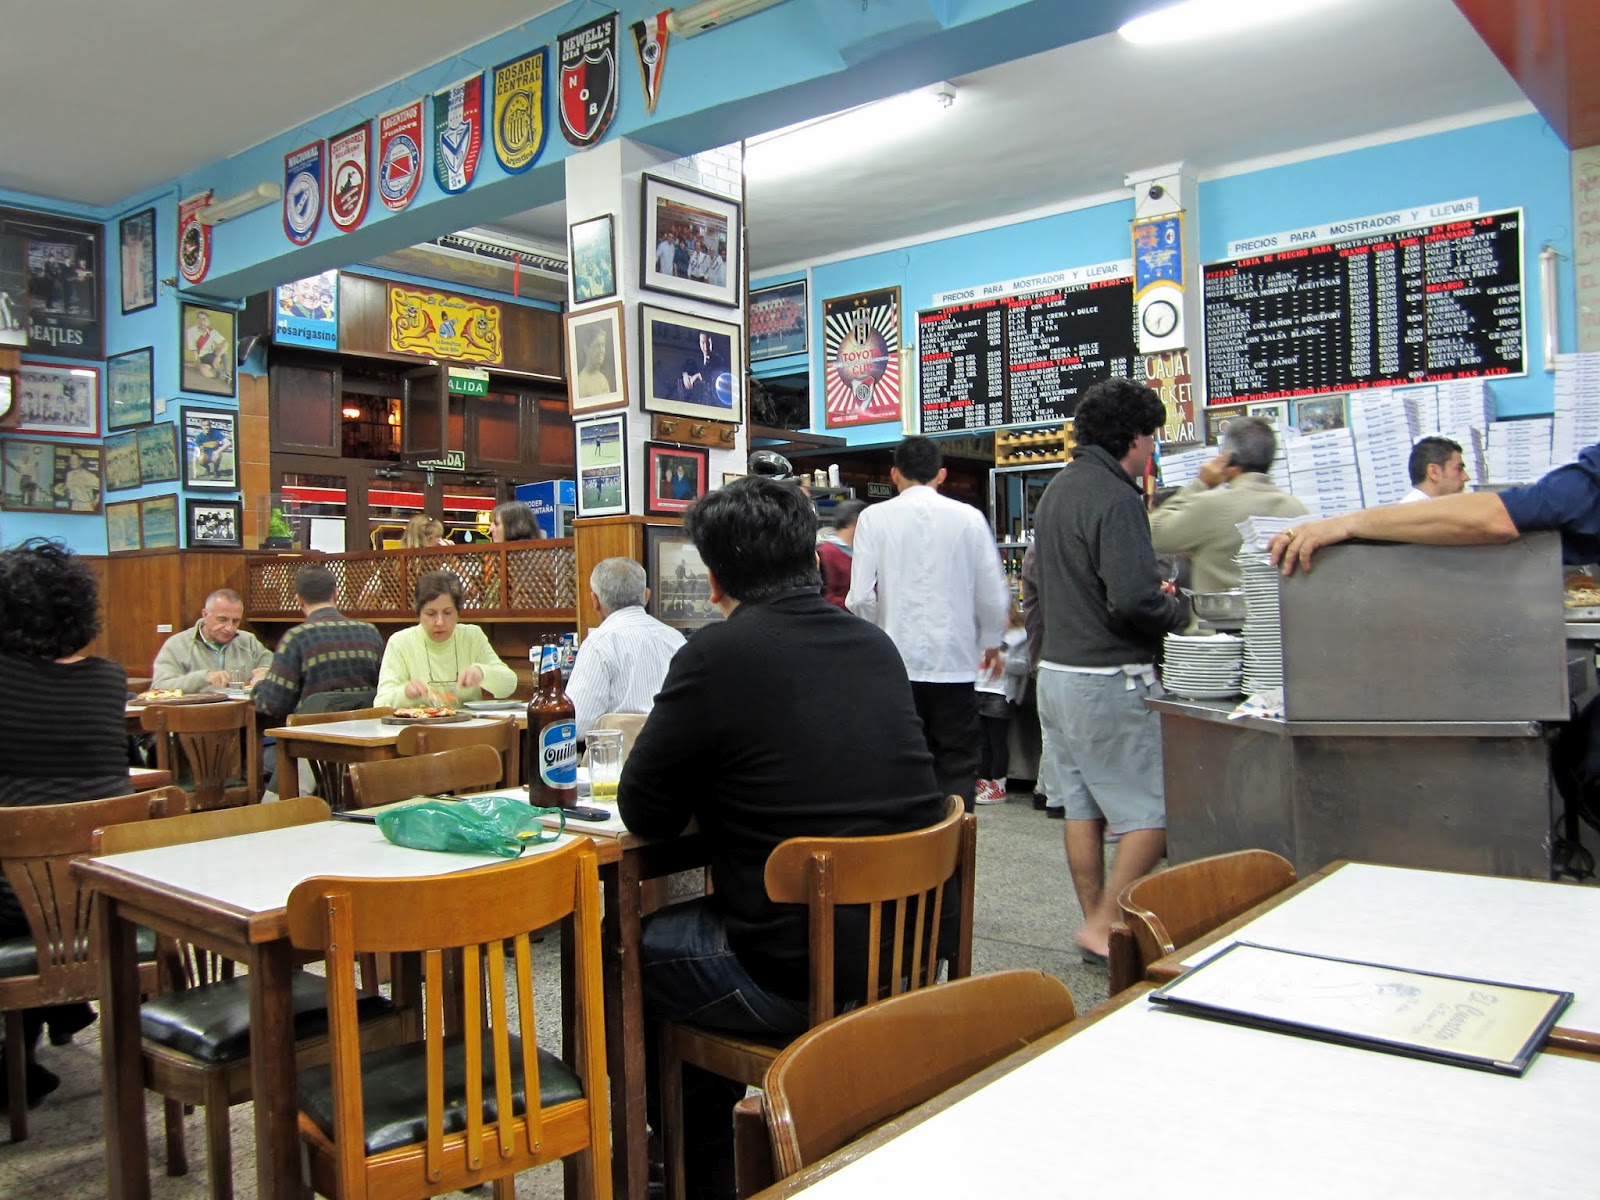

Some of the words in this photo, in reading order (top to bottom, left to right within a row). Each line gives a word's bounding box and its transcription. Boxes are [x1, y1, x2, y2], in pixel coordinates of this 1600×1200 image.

[563, 21, 612, 52] NEWELL'S
[562, 48, 580, 61] Old
[583, 38, 610, 54] Boys
[498, 56, 541, 82] ROSARIO
[498, 70, 540, 95] CENTRAL
[569, 75, 578, 88] N
[580, 88, 590, 101] O
[589, 102, 598, 116] B
[506, 150, 534, 165] Argentina
[1235, 237, 1278, 253] PRECIOS
[1290, 230, 1317, 243] PARA
[1330, 214, 1401, 236] MOSTRADOR
[1411, 211, 1419, 221] Y
[1430, 202, 1474, 218] LLEVAR
[942, 290, 975, 303] PRECIOS
[983, 285, 1004, 295] PARA
[1013, 274, 1065, 290] MOSTRADOR
[1073, 271, 1079, 280] Y
[1087, 264, 1119, 277] LLEVAR
[276, 324, 338, 342] rosarigasino
[842, 349, 882, 362] TOYOT
[447, 379, 484, 393] ALIDA
[1152, 382, 1193, 405] ICKET
[1152, 422, 1196, 444] LEVAR
[869, 485, 891, 496] SALIDA
[531, 503, 554, 515] ONTAÑA
